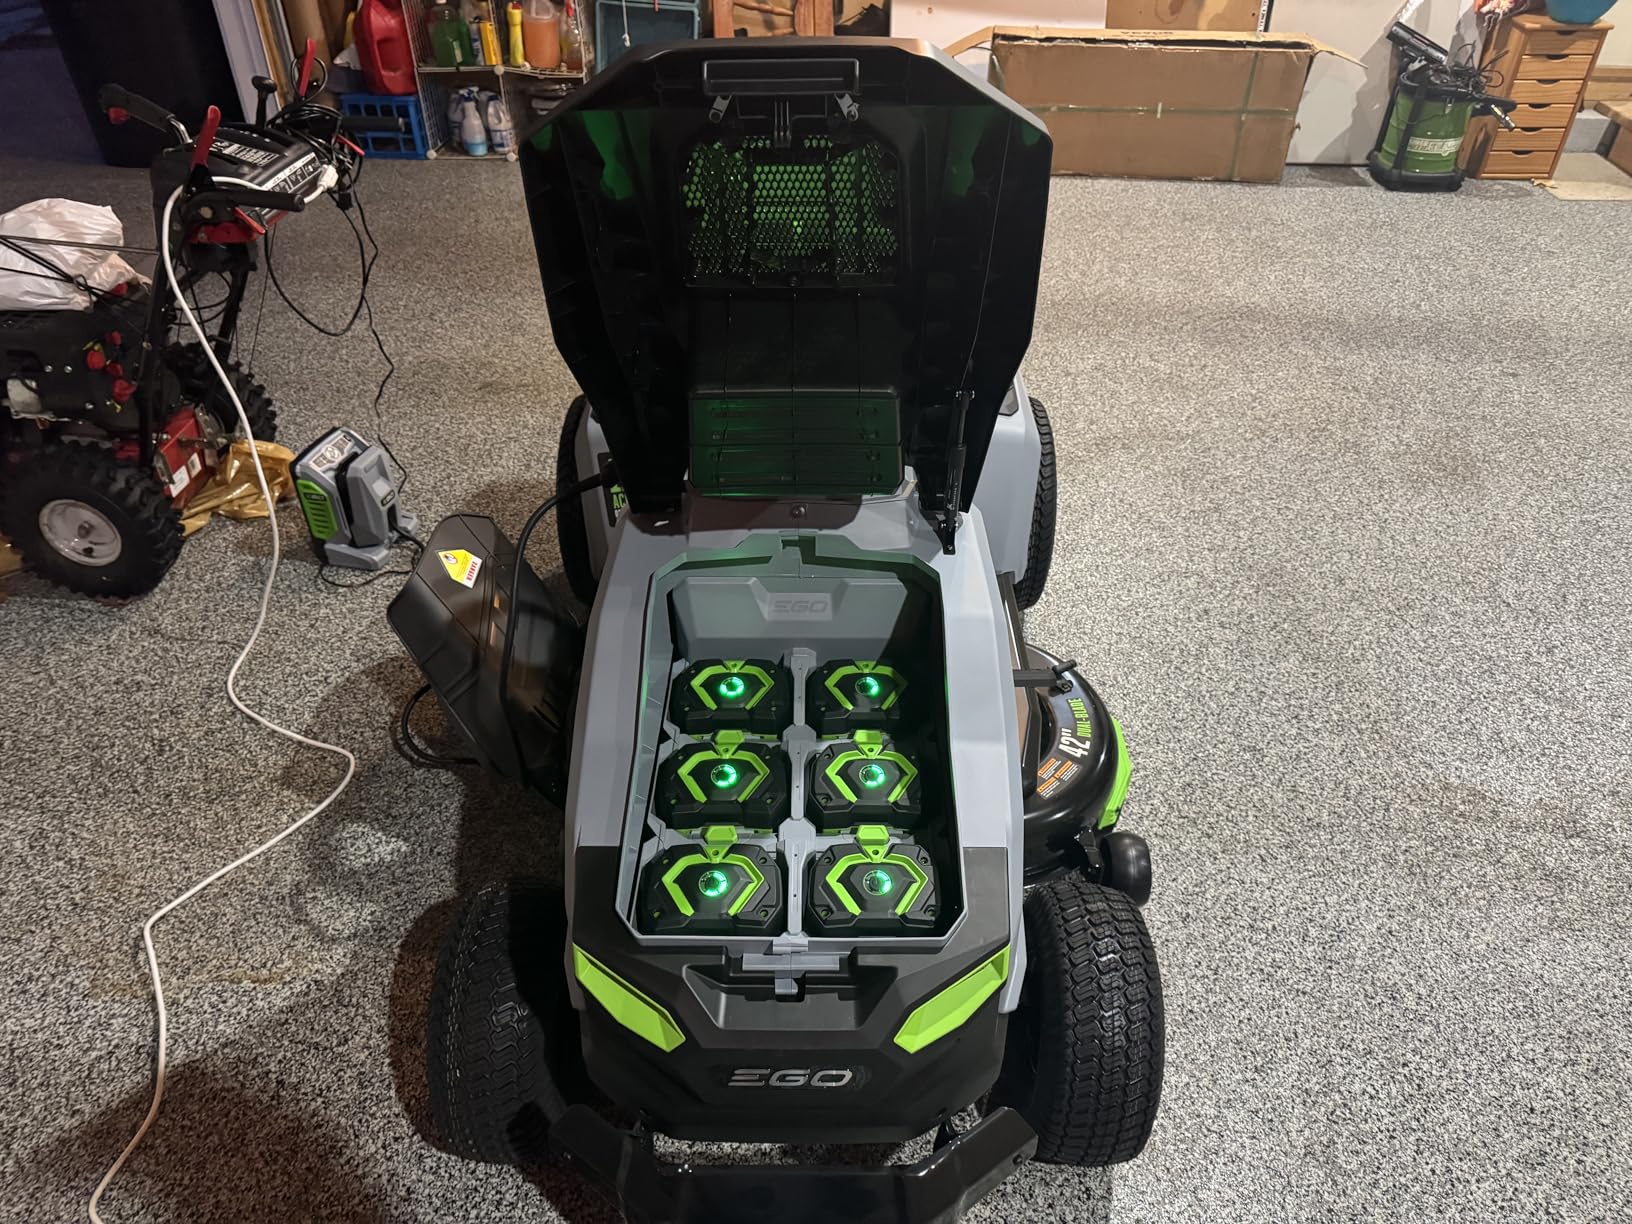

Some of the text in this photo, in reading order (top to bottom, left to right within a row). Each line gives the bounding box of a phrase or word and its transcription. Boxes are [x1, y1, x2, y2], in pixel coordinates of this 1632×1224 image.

[773, 600, 828, 614] EGO
[1067, 697, 1092, 738] DUAL-BLADE
[727, 1068, 853, 1087] EGO
